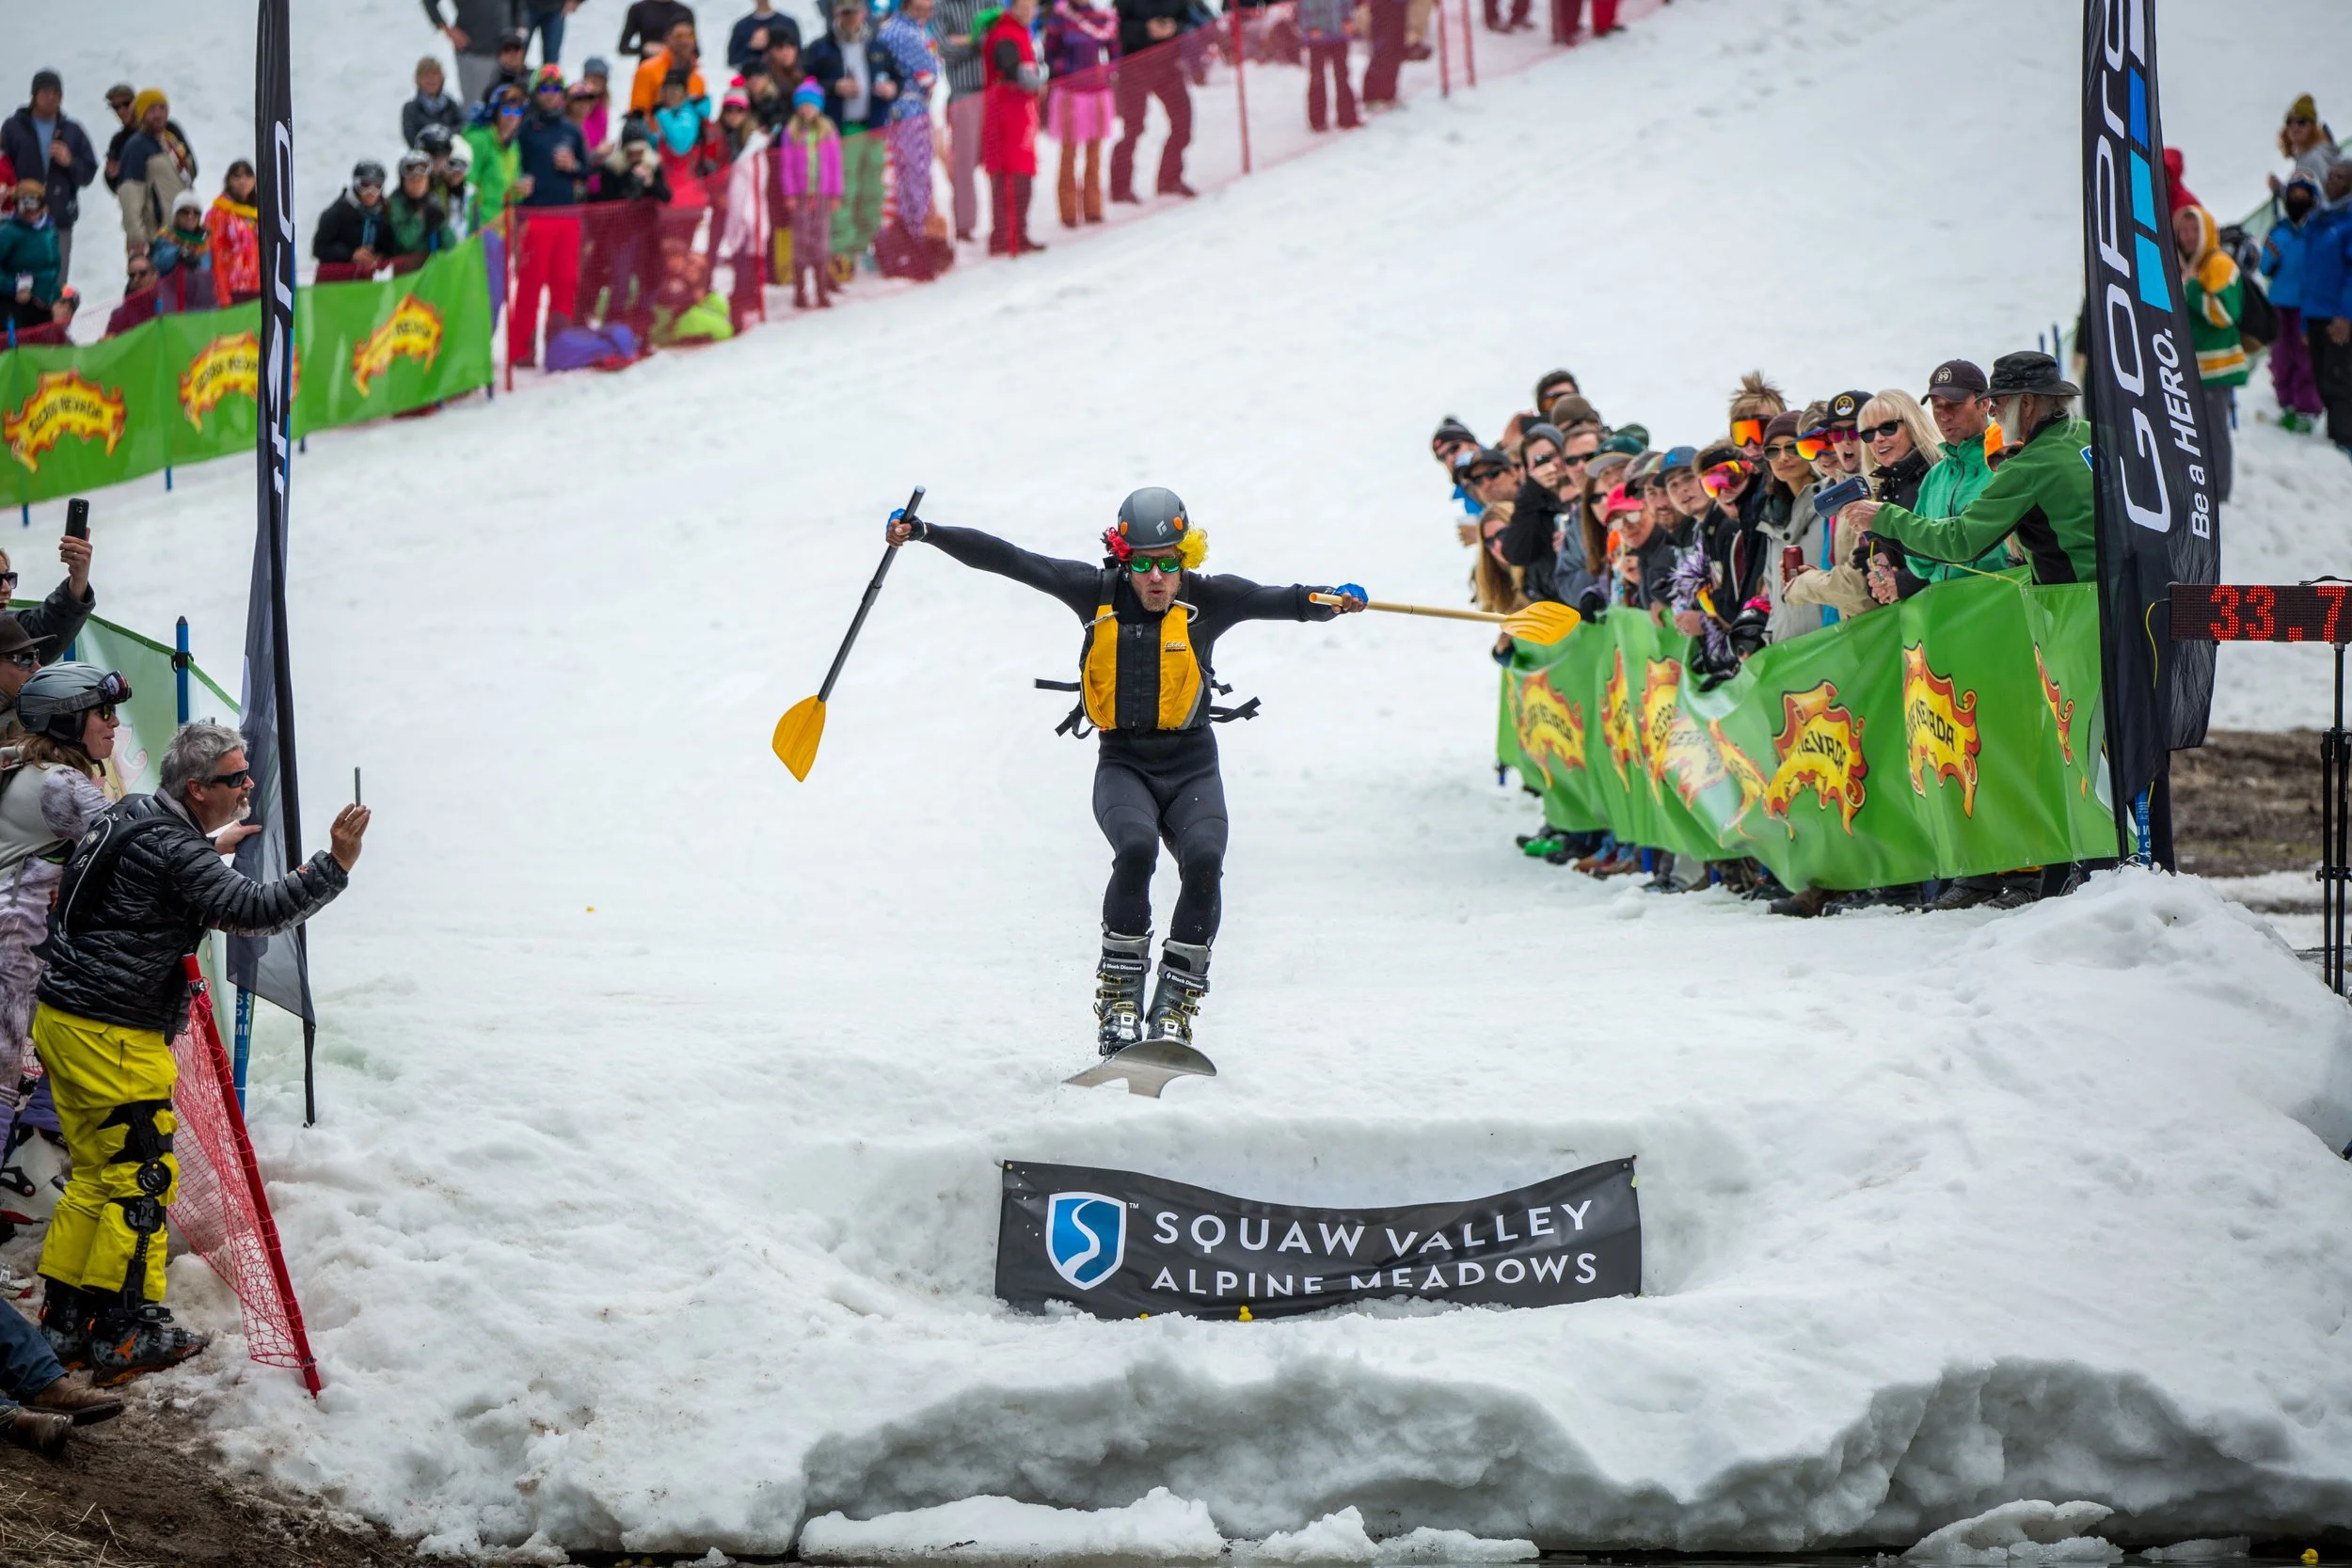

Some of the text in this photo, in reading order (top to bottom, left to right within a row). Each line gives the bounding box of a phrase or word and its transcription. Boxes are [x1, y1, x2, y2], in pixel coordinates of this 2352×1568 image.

[2189, 464, 2206, 485] a
[2191, 492, 2210, 540] Be
[1152, 1199, 1593, 1258] SQUAW VALLEY
[1151, 1252, 1597, 1298] ALPINE MEADOWS
